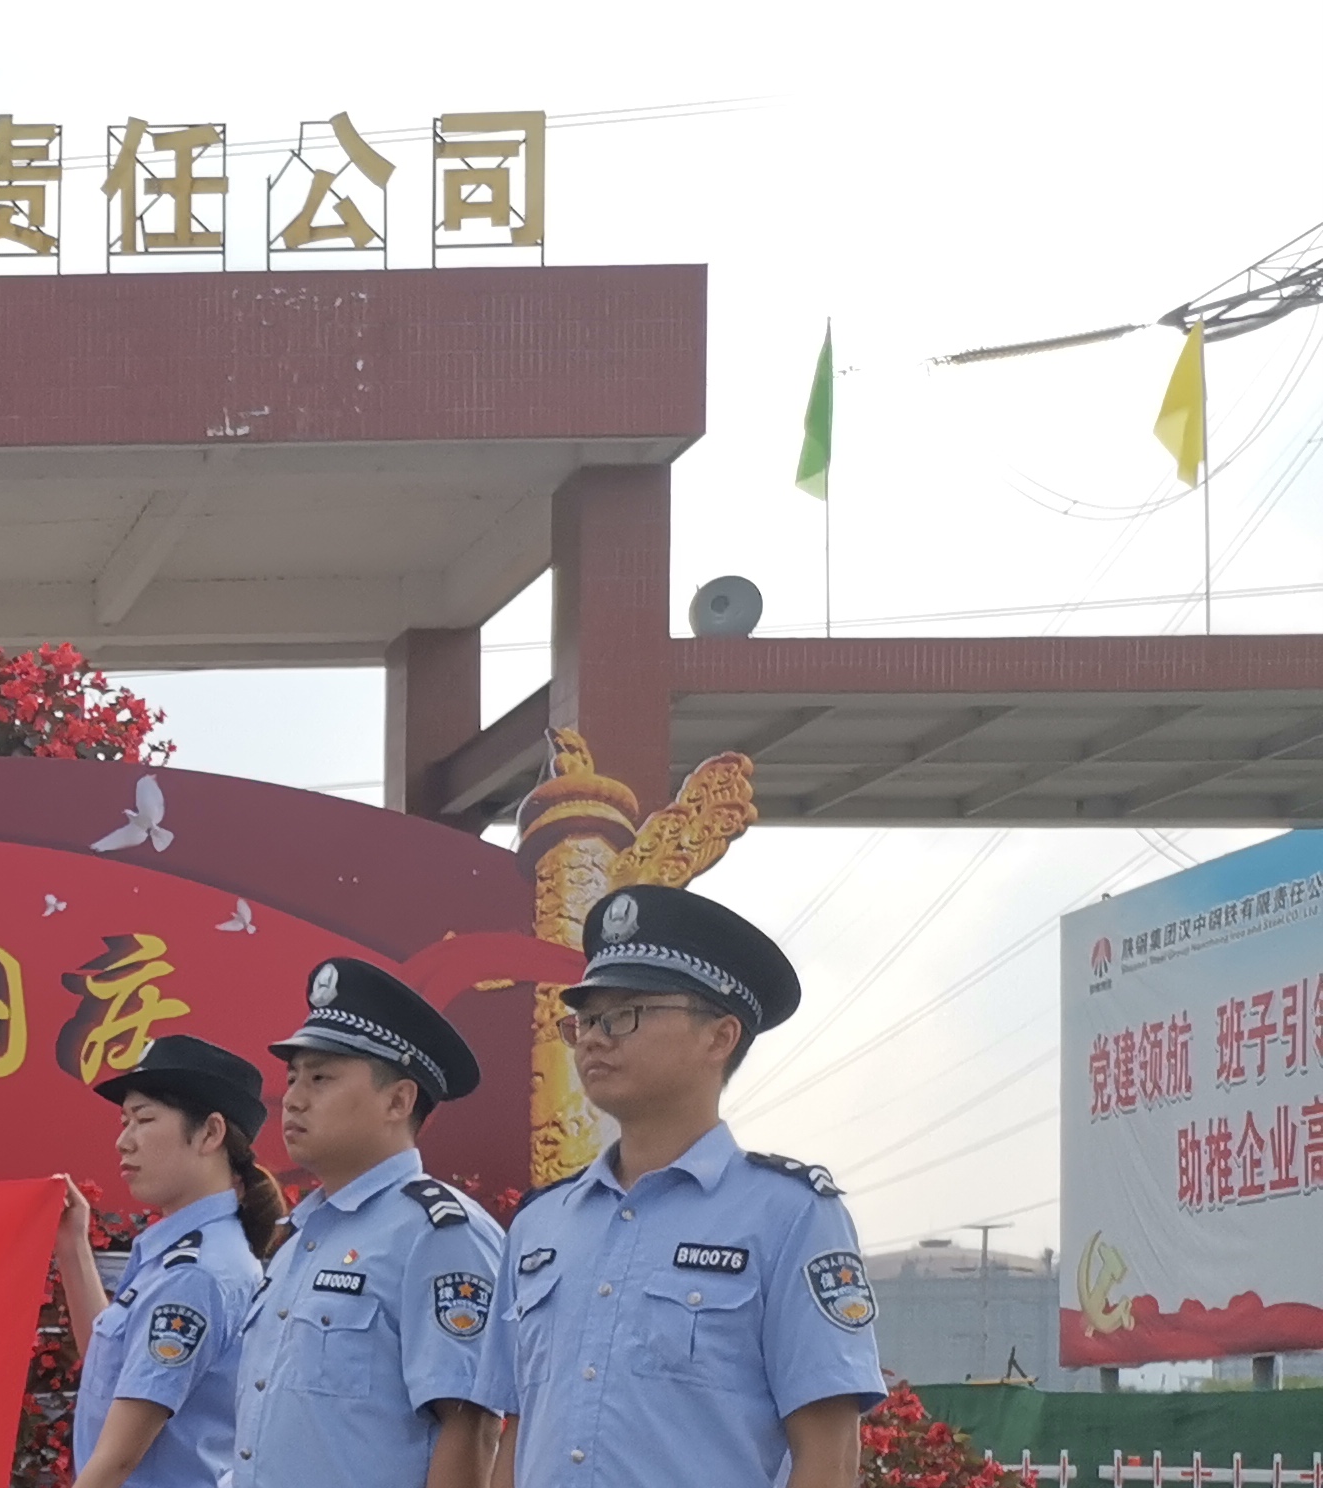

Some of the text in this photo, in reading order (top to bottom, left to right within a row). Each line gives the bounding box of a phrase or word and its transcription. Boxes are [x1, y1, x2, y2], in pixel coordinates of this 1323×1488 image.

[1089, 1009, 1194, 1118] 党建领航
[1177, 1094, 1323, 1207] 助推企业高
[676, 1247, 744, 1270] BW0076
